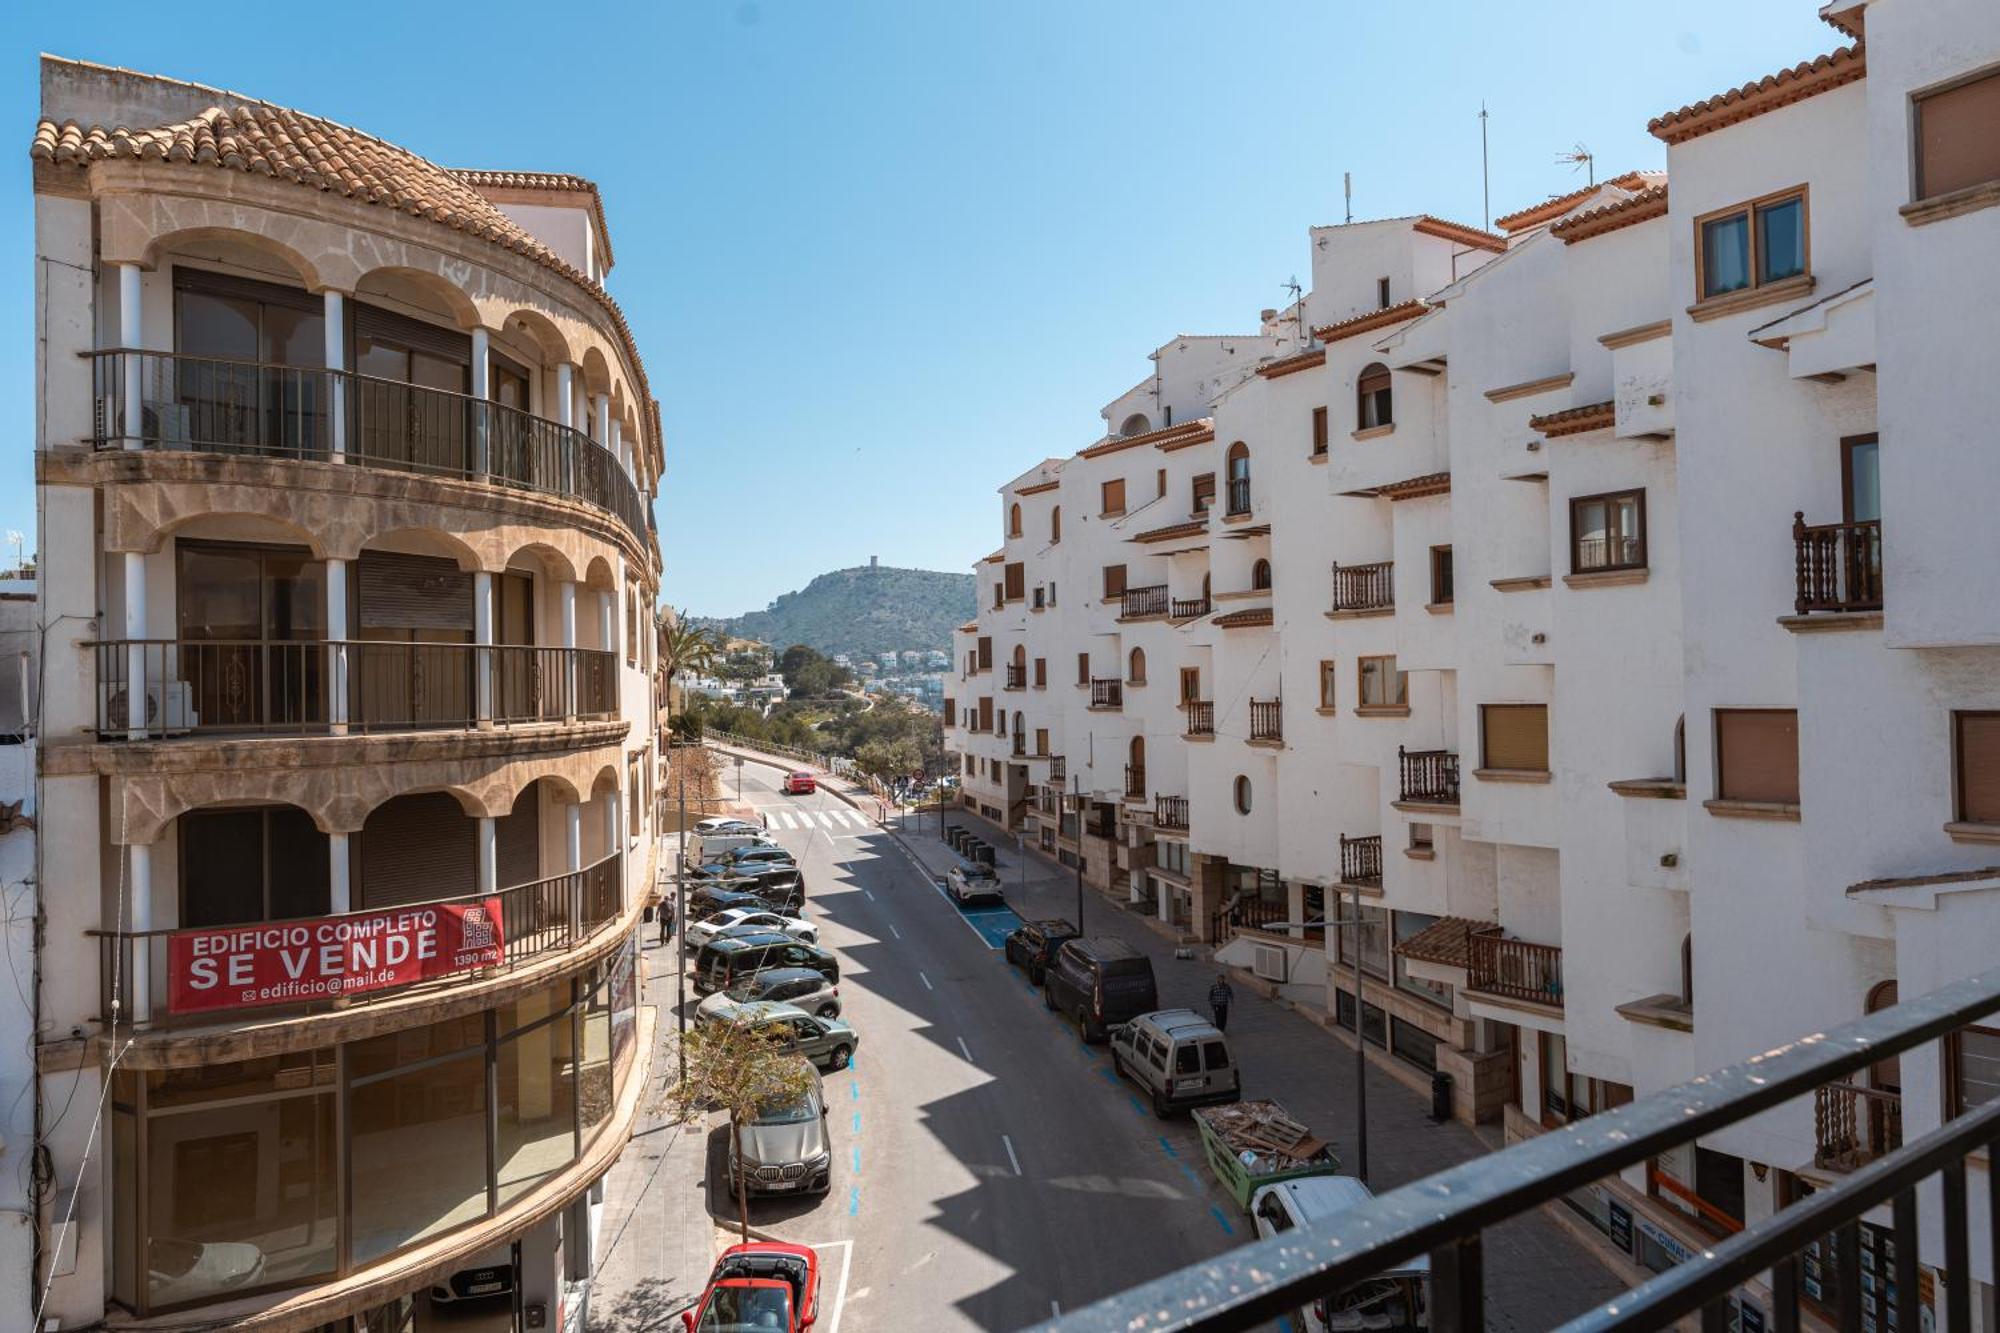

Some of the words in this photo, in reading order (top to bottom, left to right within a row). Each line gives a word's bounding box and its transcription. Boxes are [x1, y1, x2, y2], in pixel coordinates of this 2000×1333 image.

[192, 927, 309, 956] EDIFICIO
[316, 910, 437, 944] COMPLETO
[189, 953, 255, 990] SE
[279, 929, 437, 979] VENDE
[454, 952, 478, 967] 1390
[260, 968, 395, 999] edificio@mail.de
